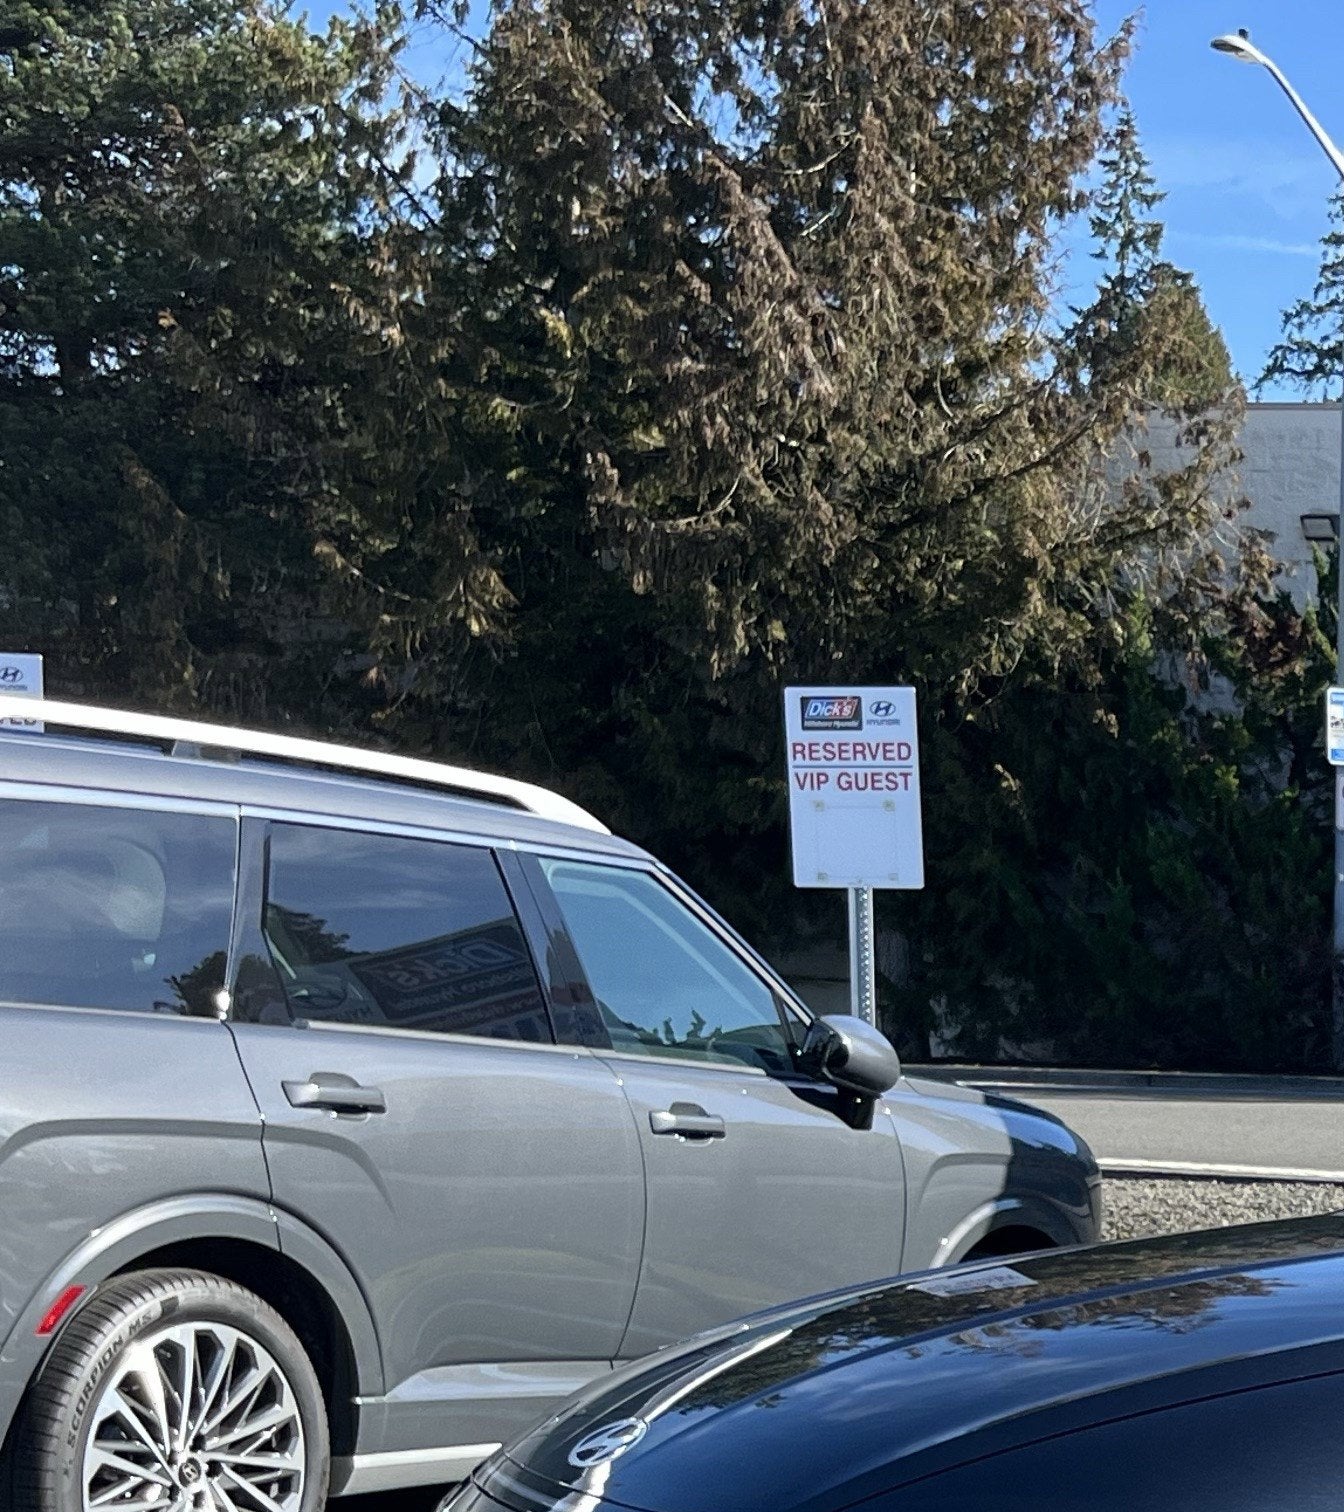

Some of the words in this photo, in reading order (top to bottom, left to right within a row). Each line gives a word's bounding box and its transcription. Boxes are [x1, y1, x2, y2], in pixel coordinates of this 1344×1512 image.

[792, 742, 912, 761] RESERVED
[795, 772, 829, 790] VIP
[836, 772, 912, 791] GUEST
[67, 1334, 124, 1448] SCORPION
